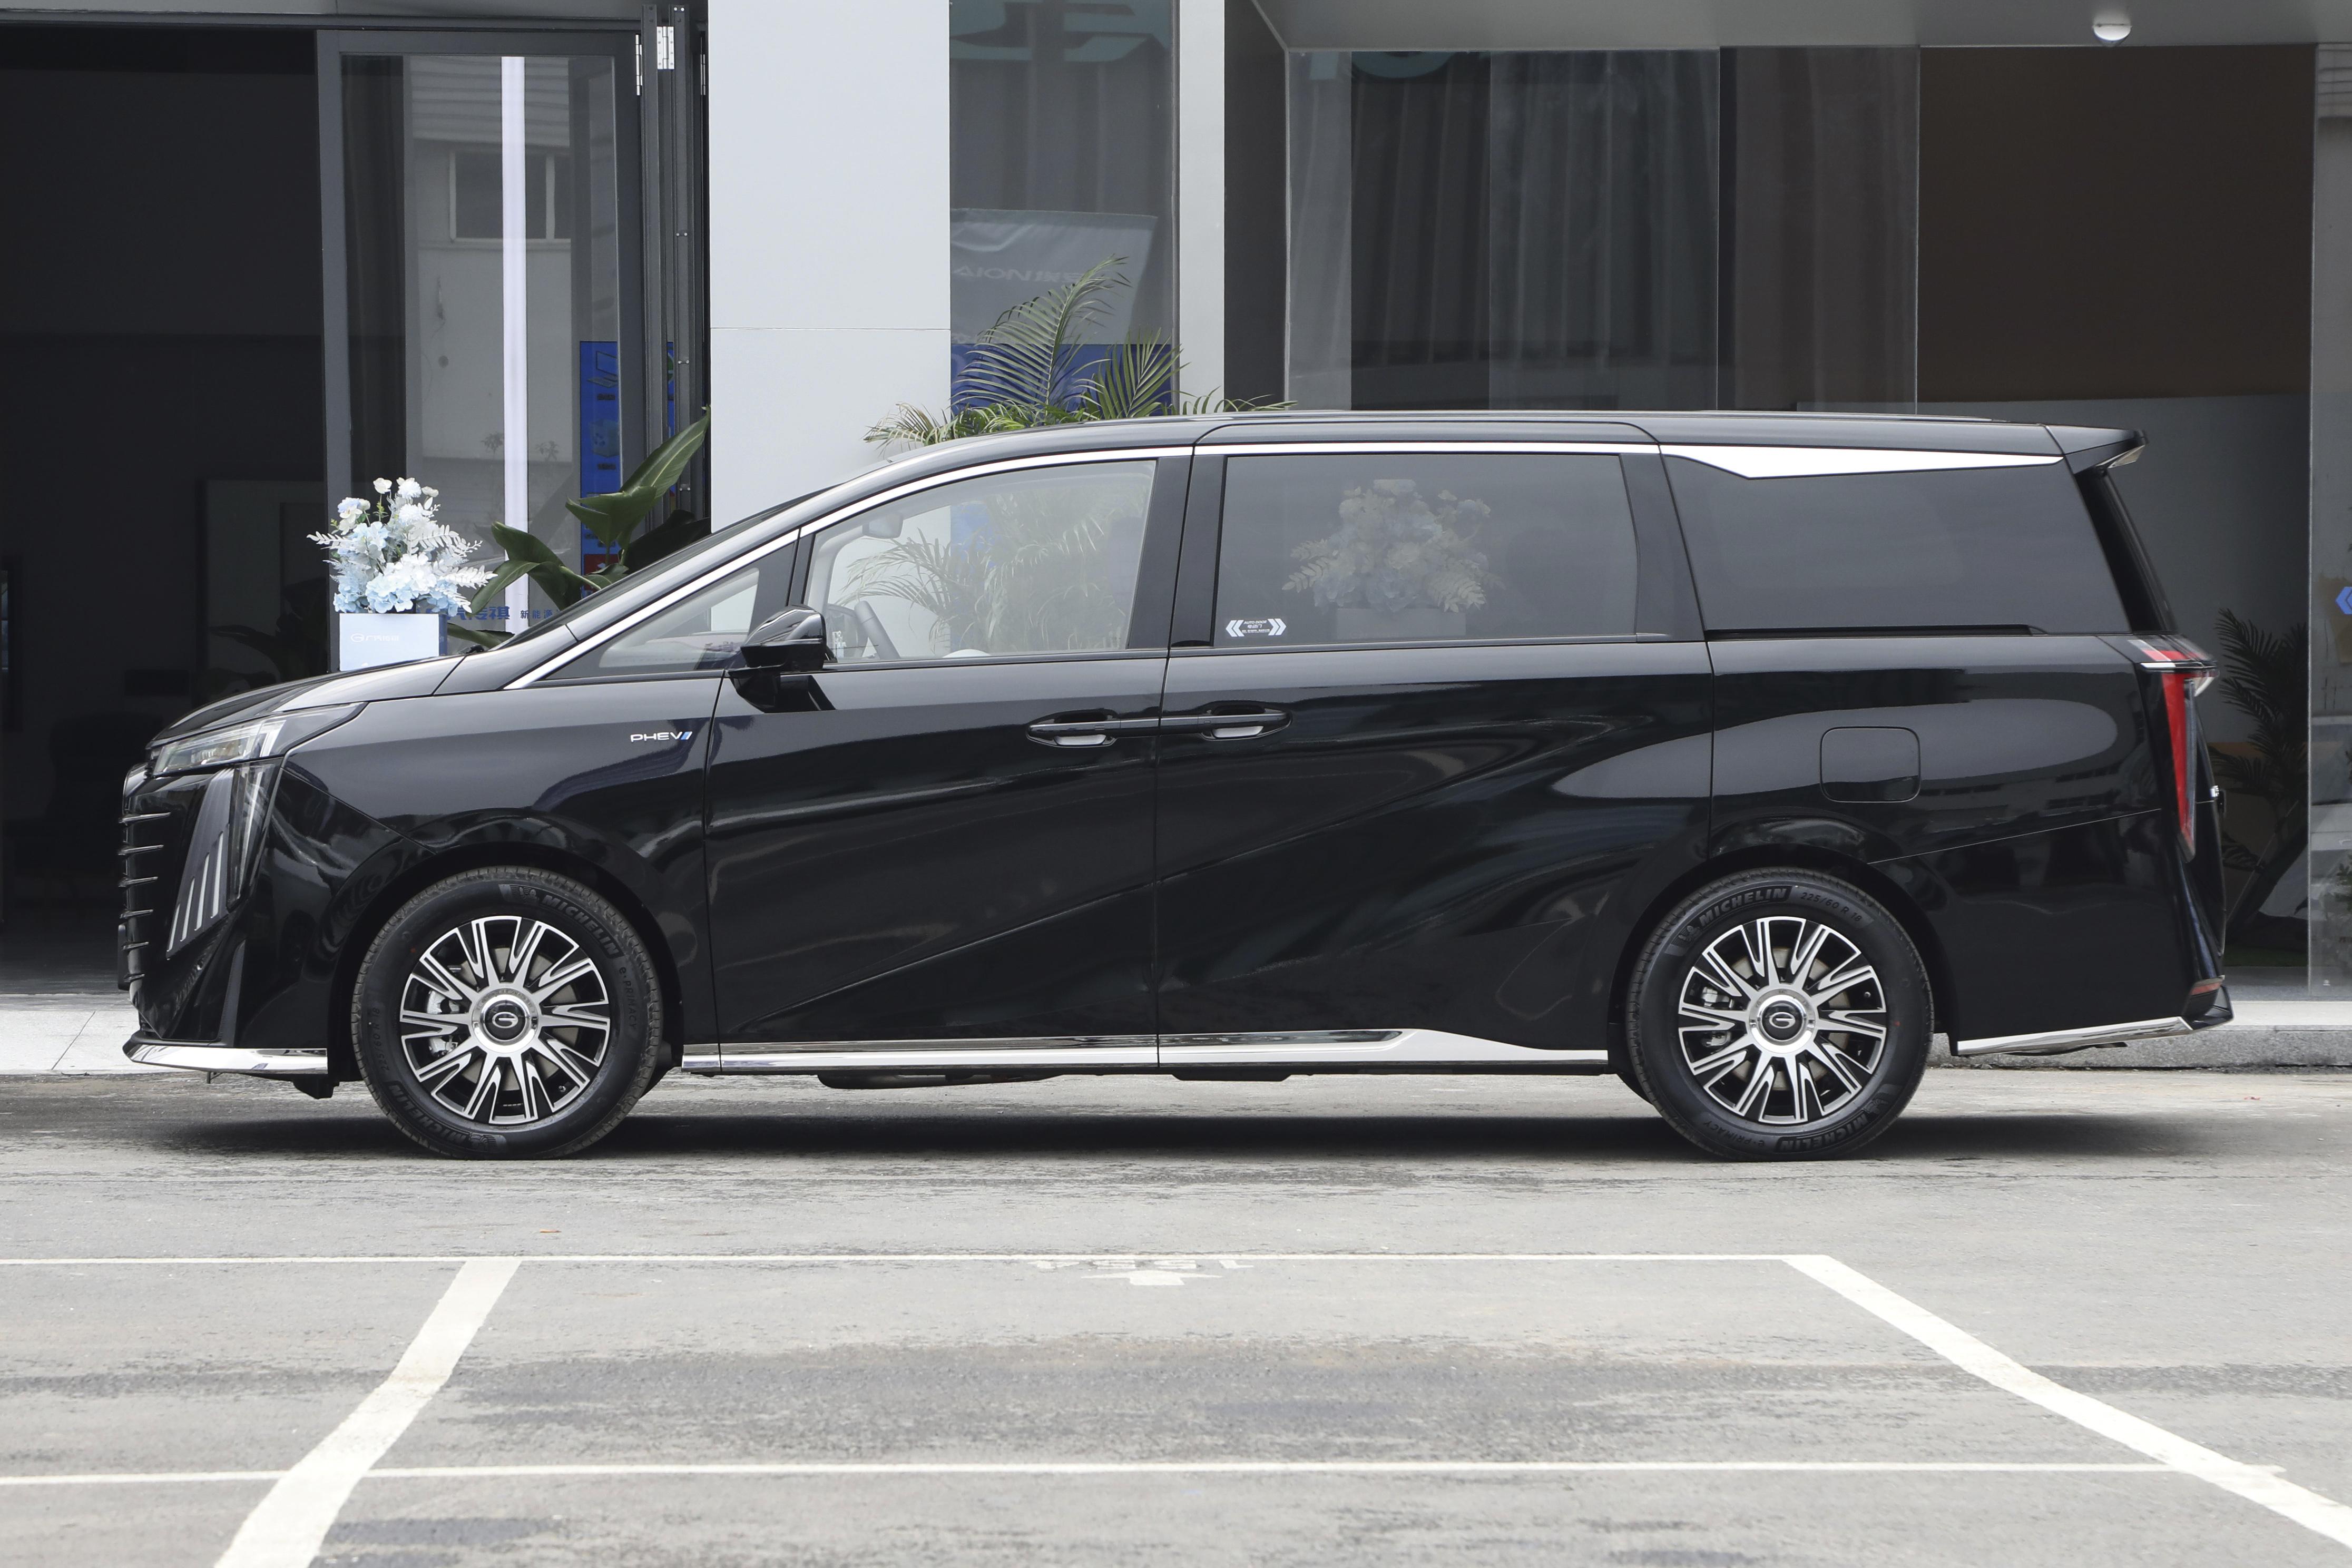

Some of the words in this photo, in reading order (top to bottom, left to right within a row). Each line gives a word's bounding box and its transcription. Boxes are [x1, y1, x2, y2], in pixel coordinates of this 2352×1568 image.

[630, 731, 683, 743] PHEV
[541, 894, 620, 955] MICHELIN
[1698, 888, 1787, 927] MICHELIN
[1800, 892, 1839, 909] 225/60
[1840, 904, 1850, 914] R
[1851, 912, 1863, 923] 18
[388, 1084, 467, 1143] MICHELIN
[1779, 1113, 1869, 1152] MICHELIN
